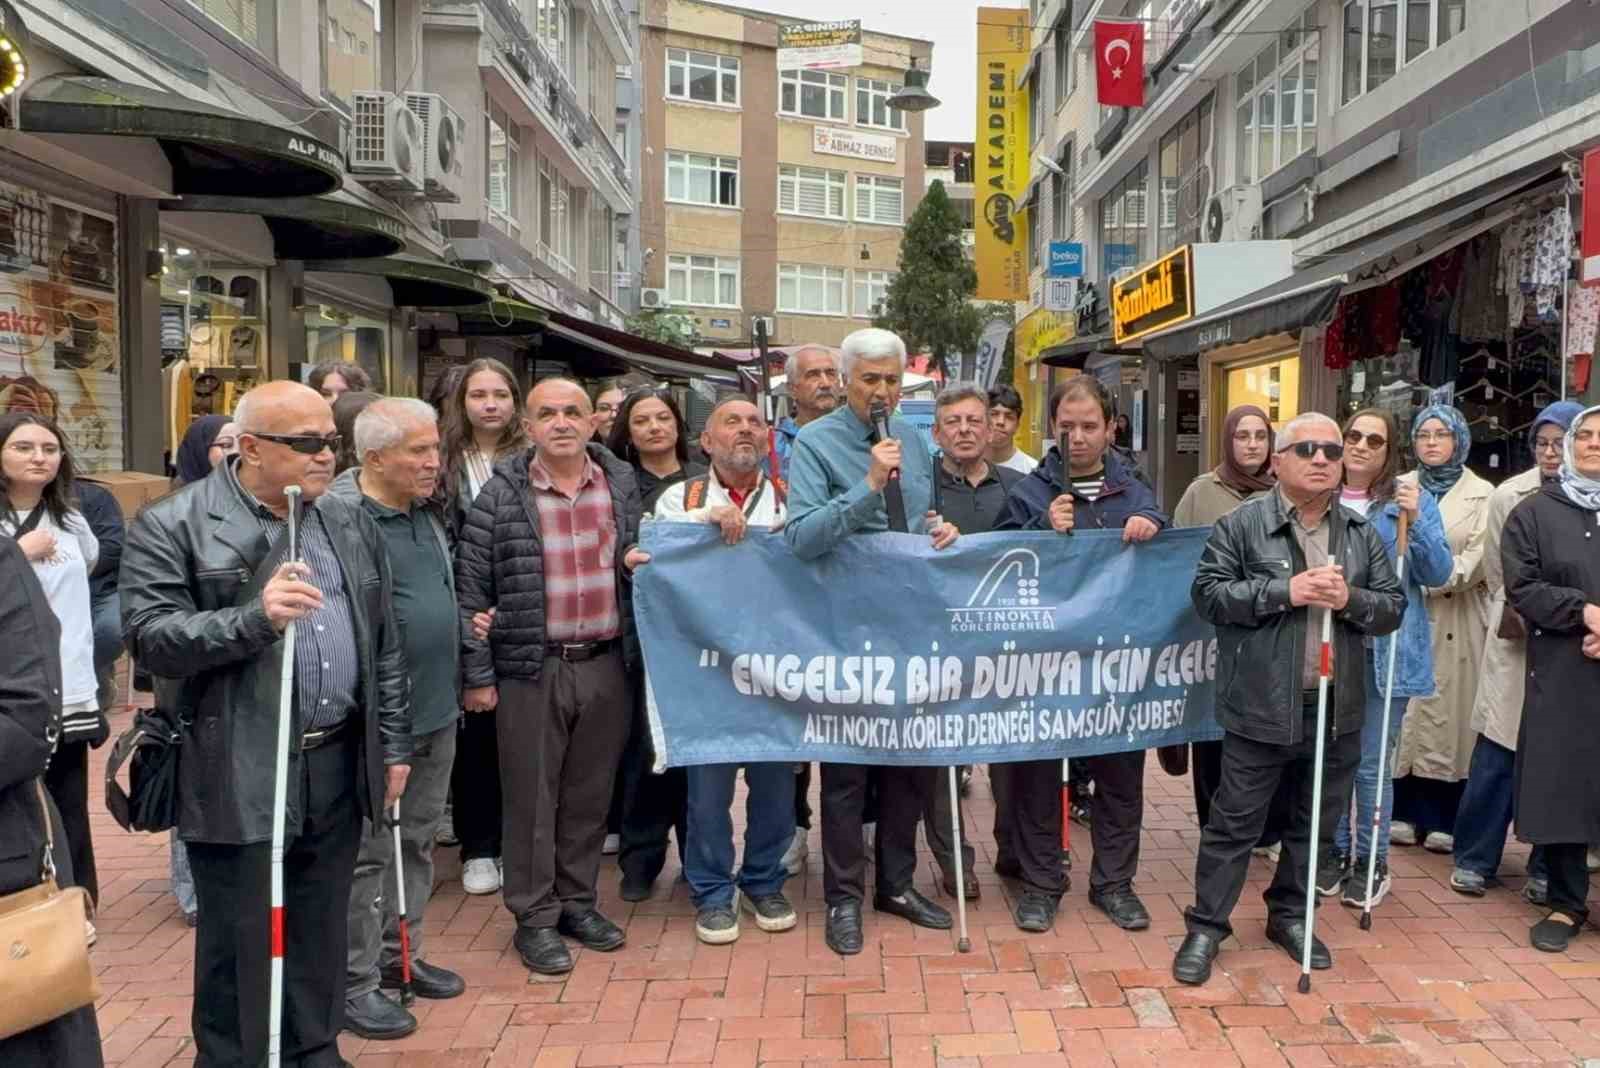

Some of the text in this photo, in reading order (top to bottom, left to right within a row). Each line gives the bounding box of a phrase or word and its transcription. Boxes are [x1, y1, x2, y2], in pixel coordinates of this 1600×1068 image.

[288, 138, 316, 156] ALP
[831, 139, 862, 154] ABHAZ
[951, 611, 1055, 623] ALTINOKTA
[732, 641, 896, 705] ENGELSİZ
[906, 641, 963, 704] BİR
[971, 640, 1082, 699] DÜNYA
[1092, 635, 1151, 704] İÇİN
[1155, 638, 1218, 687] ELELE
[803, 690, 1188, 749] ALTI NOKTA KÖRLER DERNEĞİ SAMSUN ŞUBESİ
